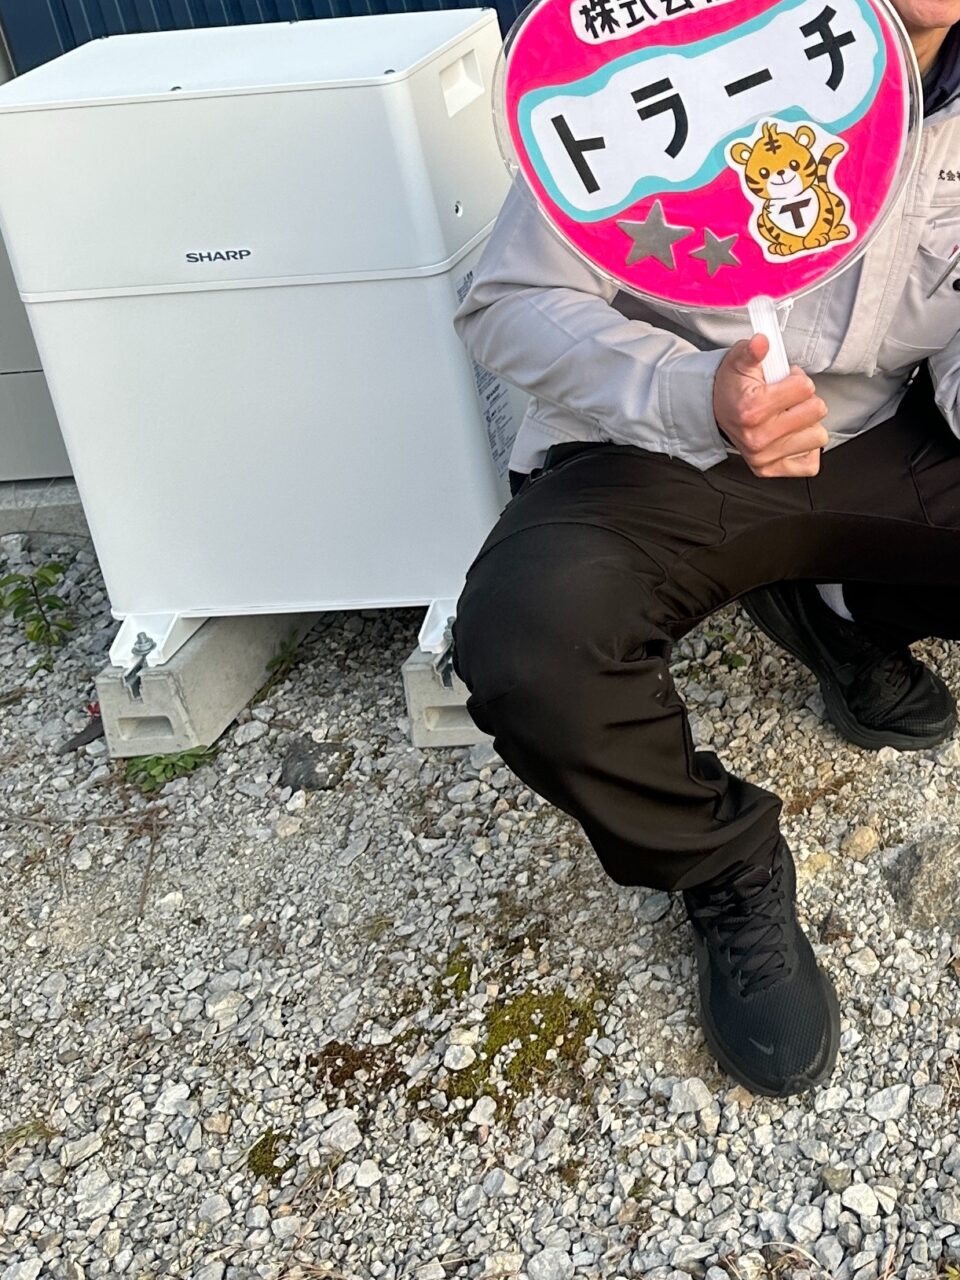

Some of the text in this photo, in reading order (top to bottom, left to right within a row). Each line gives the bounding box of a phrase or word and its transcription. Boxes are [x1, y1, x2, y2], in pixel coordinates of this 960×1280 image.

[550, 5, 856, 195] トラーチ
[778, 198, 813, 230] T
[185, 249, 252, 264] SHARP
